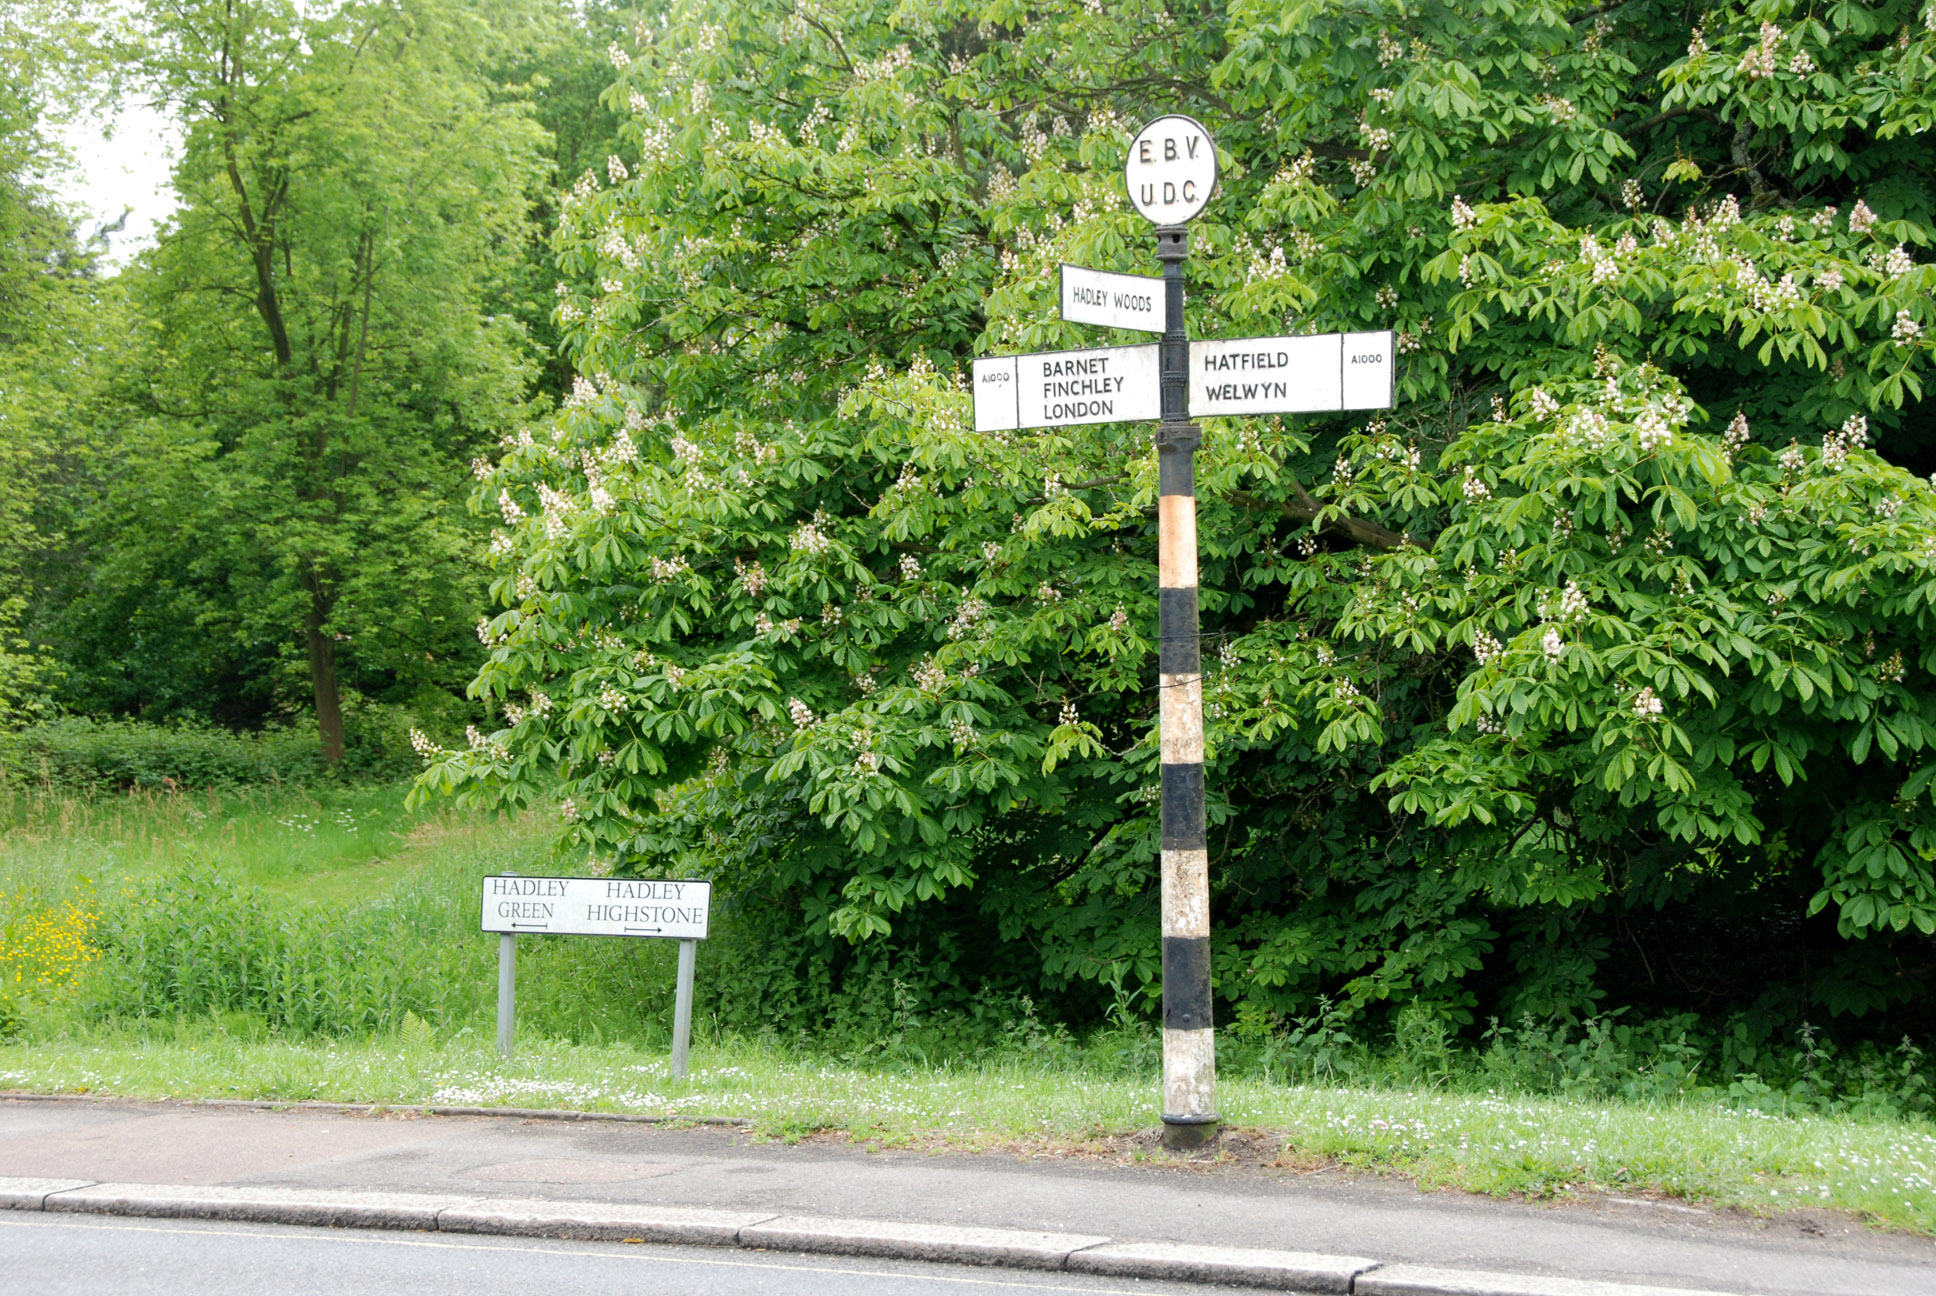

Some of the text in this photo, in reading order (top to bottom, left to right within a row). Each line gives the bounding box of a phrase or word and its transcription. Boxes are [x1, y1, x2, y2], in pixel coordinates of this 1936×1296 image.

[1073, 286, 1152, 312] HADLEY WOODS
[1043, 358, 1109, 377] BARNET
[1205, 352, 1289, 371] HATFIELD
[1351, 354, 1383, 364] A1000
[1044, 377, 1124, 399] FINCHLEY
[1205, 382, 1287, 402] WELWYN
[1044, 400, 1113, 420] LONDON
[493, 879, 570, 897] HADLEY
[607, 882, 686, 900] HADLEY
[497, 901, 554, 919] GREEN
[587, 905, 703, 924] HIGHSTONE
